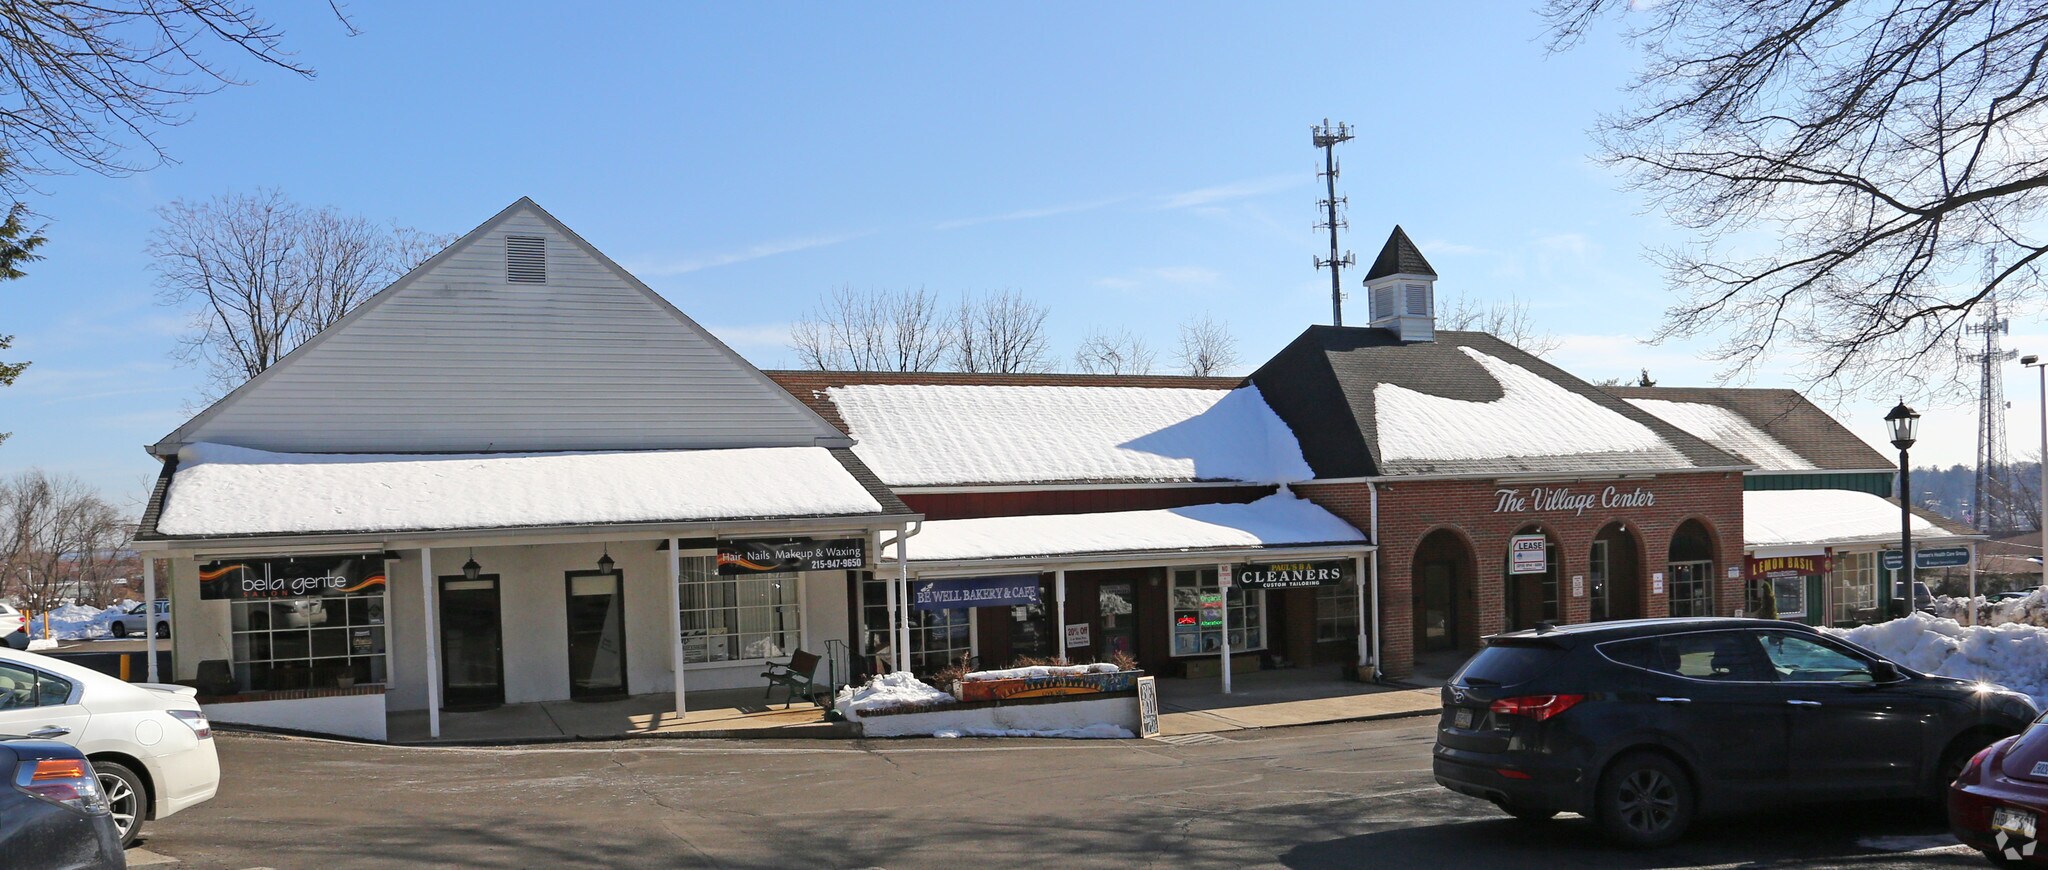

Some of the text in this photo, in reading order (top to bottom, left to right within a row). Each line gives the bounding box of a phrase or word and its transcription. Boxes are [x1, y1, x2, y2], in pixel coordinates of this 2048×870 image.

[1494, 485, 1655, 517] The Village Center
[1518, 541, 1543, 550] LEASE
[722, 547, 861, 561] Hair Nails Makeup & Waxing
[811, 558, 862, 569] 215-947-9650
[1752, 557, 1784, 576] LEMON
[1787, 557, 1815, 571] BASIL
[241, 563, 346, 595] bella gente
[1241, 568, 1341, 583] CLEANERS
[243, 590, 289, 598] SALON
[917, 591, 932, 604] BE
[932, 590, 962, 602] WELL
[963, 588, 1003, 600] BAKERY
[1003, 589, 1012, 599] &
